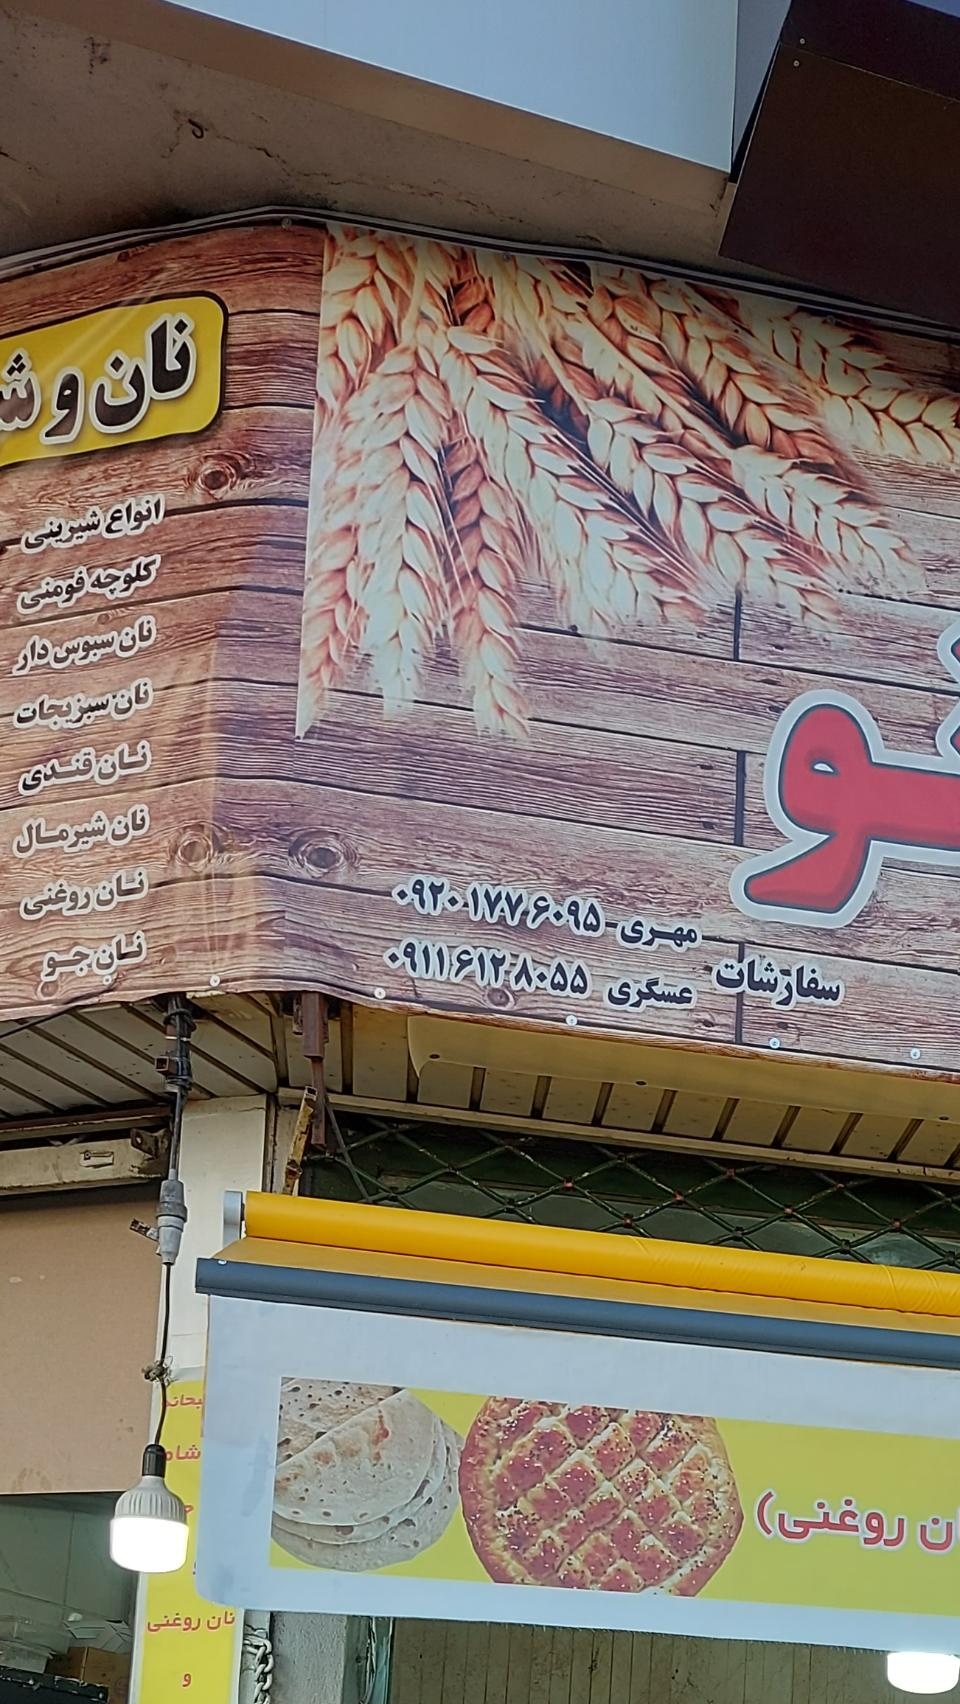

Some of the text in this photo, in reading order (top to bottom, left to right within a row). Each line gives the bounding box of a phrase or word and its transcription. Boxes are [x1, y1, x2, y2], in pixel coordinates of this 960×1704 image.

[93, 317, 192, 428] نان
[43, 372, 80, 439] و
[23, 497, 162, 549] انواع شیرینی
[20, 558, 157, 610] کلوچه فومنی
[15, 618, 153, 672] نان سبوس دار
[16, 681, 150, 725] نان سبزیجات
[21, 744, 148, 791] نان قندی
[15, 807, 147, 854] نان شیرمال
[22, 870, 146, 916] نان روغنی
[44, 933, 144, 978] نان جو
[619, 918, 699, 948] مهری
[606, 977, 694, 1008] عسگری
[714, 957, 842, 1007] سفارشات
[166, 1394, 203, 1409] بحان
[146, 1610, 236, 1633] نان روغنی
[181, 1672, 193, 1688] و
